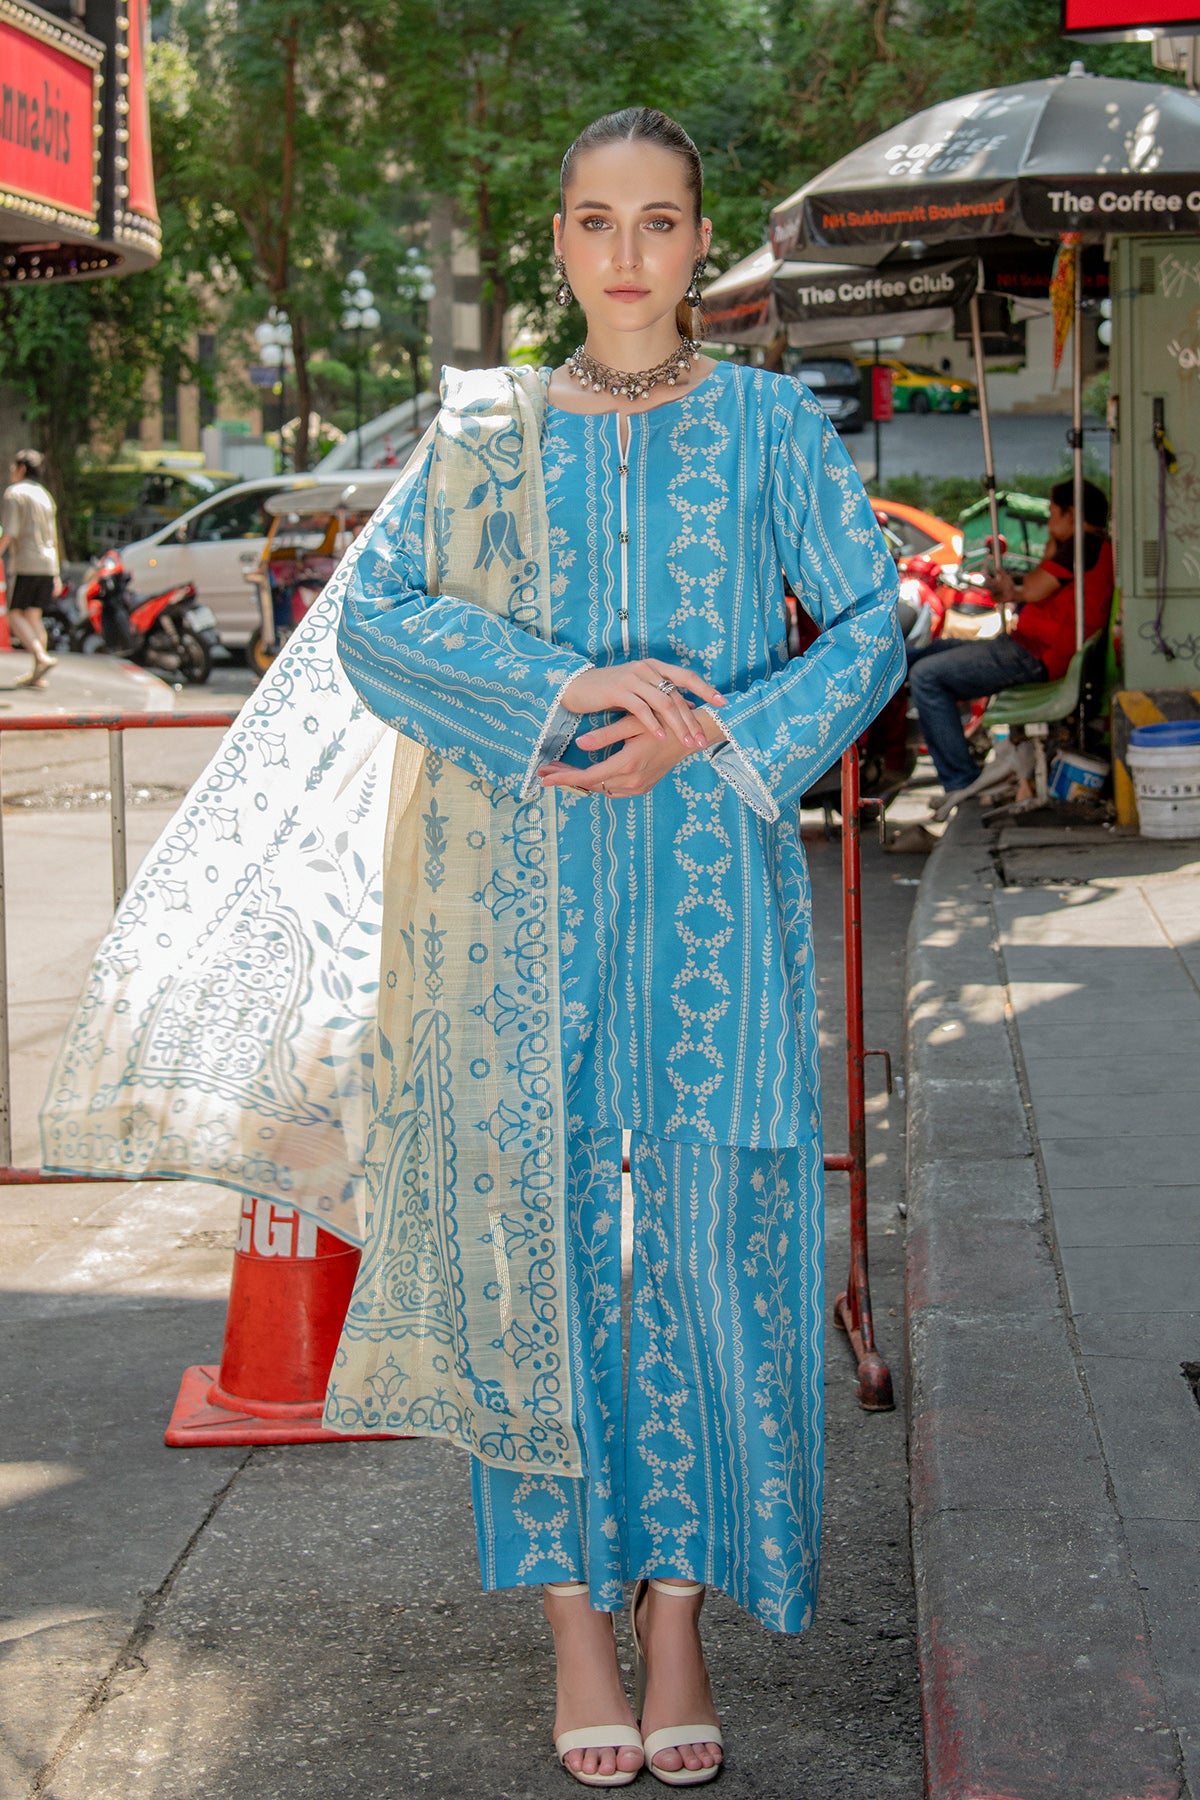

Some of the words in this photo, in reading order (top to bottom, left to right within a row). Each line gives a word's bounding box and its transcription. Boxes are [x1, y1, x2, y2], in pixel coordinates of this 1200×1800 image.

[0, 81, 70, 164] nnabis
[884, 134, 1008, 161] COFFEE
[888, 154, 972, 176] CLUB
[822, 212, 847, 229] NH
[847, 206, 927, 227] Sukhumvit
[928, 198, 1005, 221] Boulevard
[1047, 190, 1095, 213] The
[1098, 190, 1183, 213] Coffee
[798, 286, 836, 306] The
[837, 278, 907, 302] Coffee
[908, 271, 955, 295] Club
